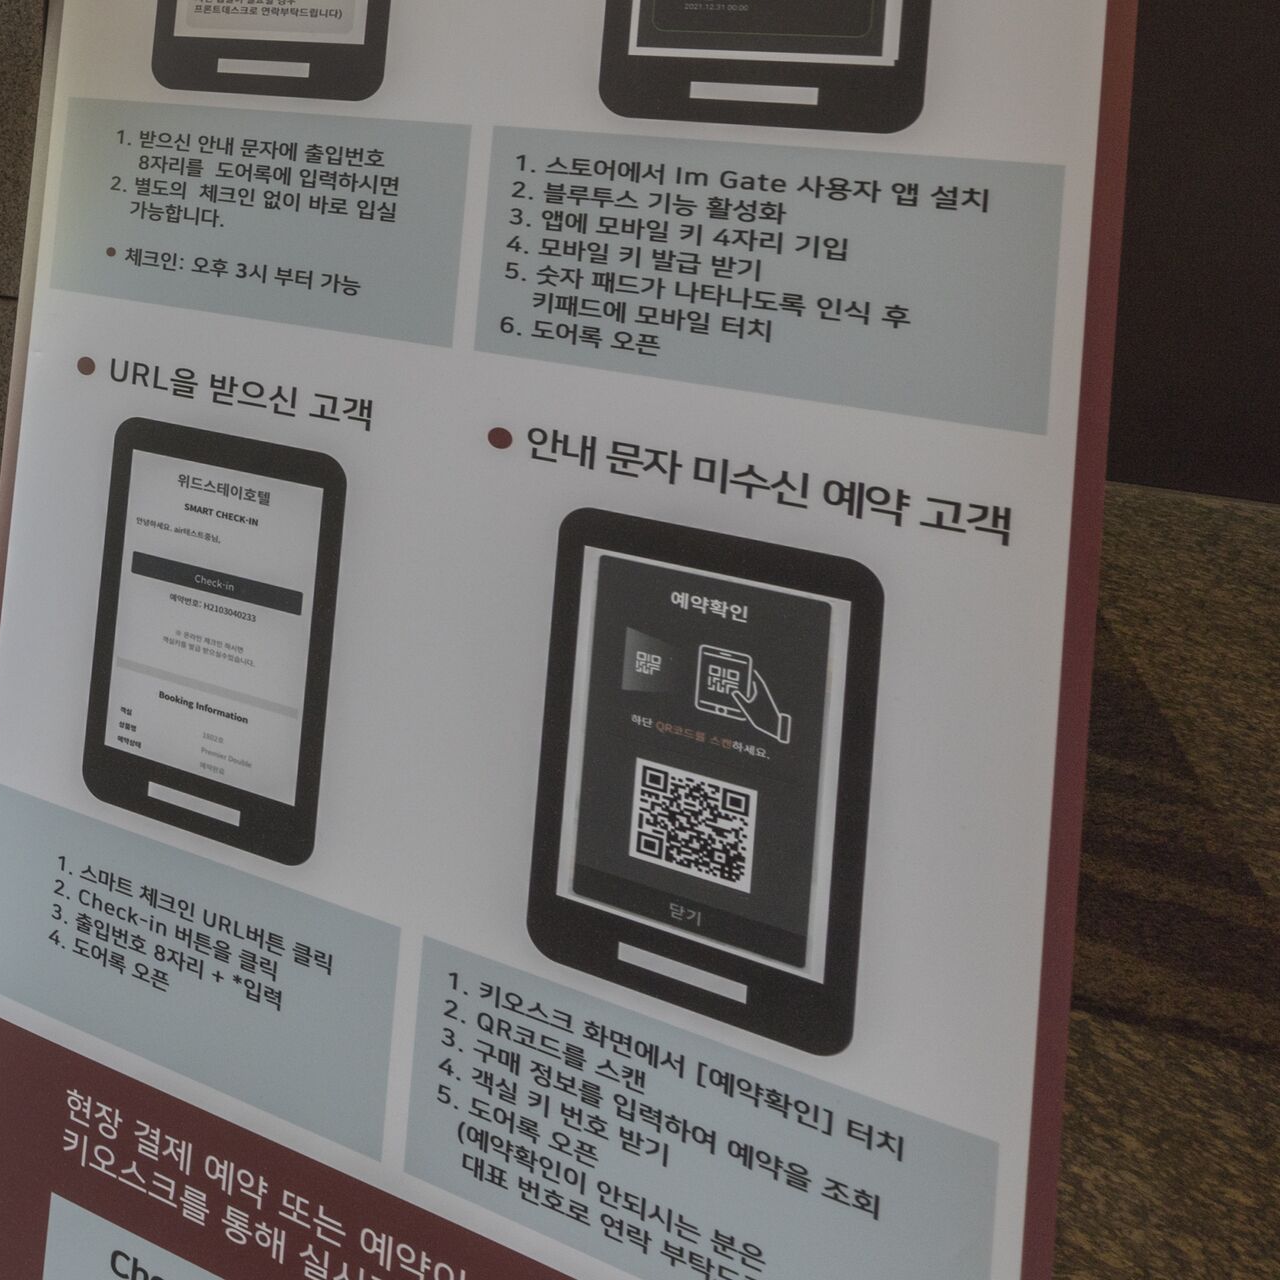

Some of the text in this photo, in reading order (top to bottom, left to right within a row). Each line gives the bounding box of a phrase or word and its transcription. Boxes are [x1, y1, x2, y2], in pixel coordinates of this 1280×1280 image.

[117, 129, 385, 168] 1. 받으신 안내 문자에 출입번호
[515, 154, 536, 173] 1.
[545, 155, 666, 186] 스토어에서
[720, 170, 787, 194] Gate
[797, 175, 881, 204] 사용자
[890, 182, 919, 207] 앱
[930, 186, 990, 213] 설치
[110, 358, 373, 432] URL을 받으신 고객
[177, 473, 271, 507] 위드스테이호텔
[527, 427, 1012, 547] 안내 문자 미수신 예약 고객
[184, 503, 259, 527] SMART CHECK-IN
[194, 574, 235, 592] Check-in
[203, 602, 257, 624] H2103040233
[670, 590, 749, 624] 예약확인
[159, 691, 249, 724] Booking Information
[669, 902, 702, 927] 닫기
[78, 889, 278, 981] Check-in 버튼을 클릭
[448, 972, 905, 1163] 1. 키오스크 화면에서 [예약확인] 터치
[65, 1088, 346, 1247] 현장 결제 예약 또는
